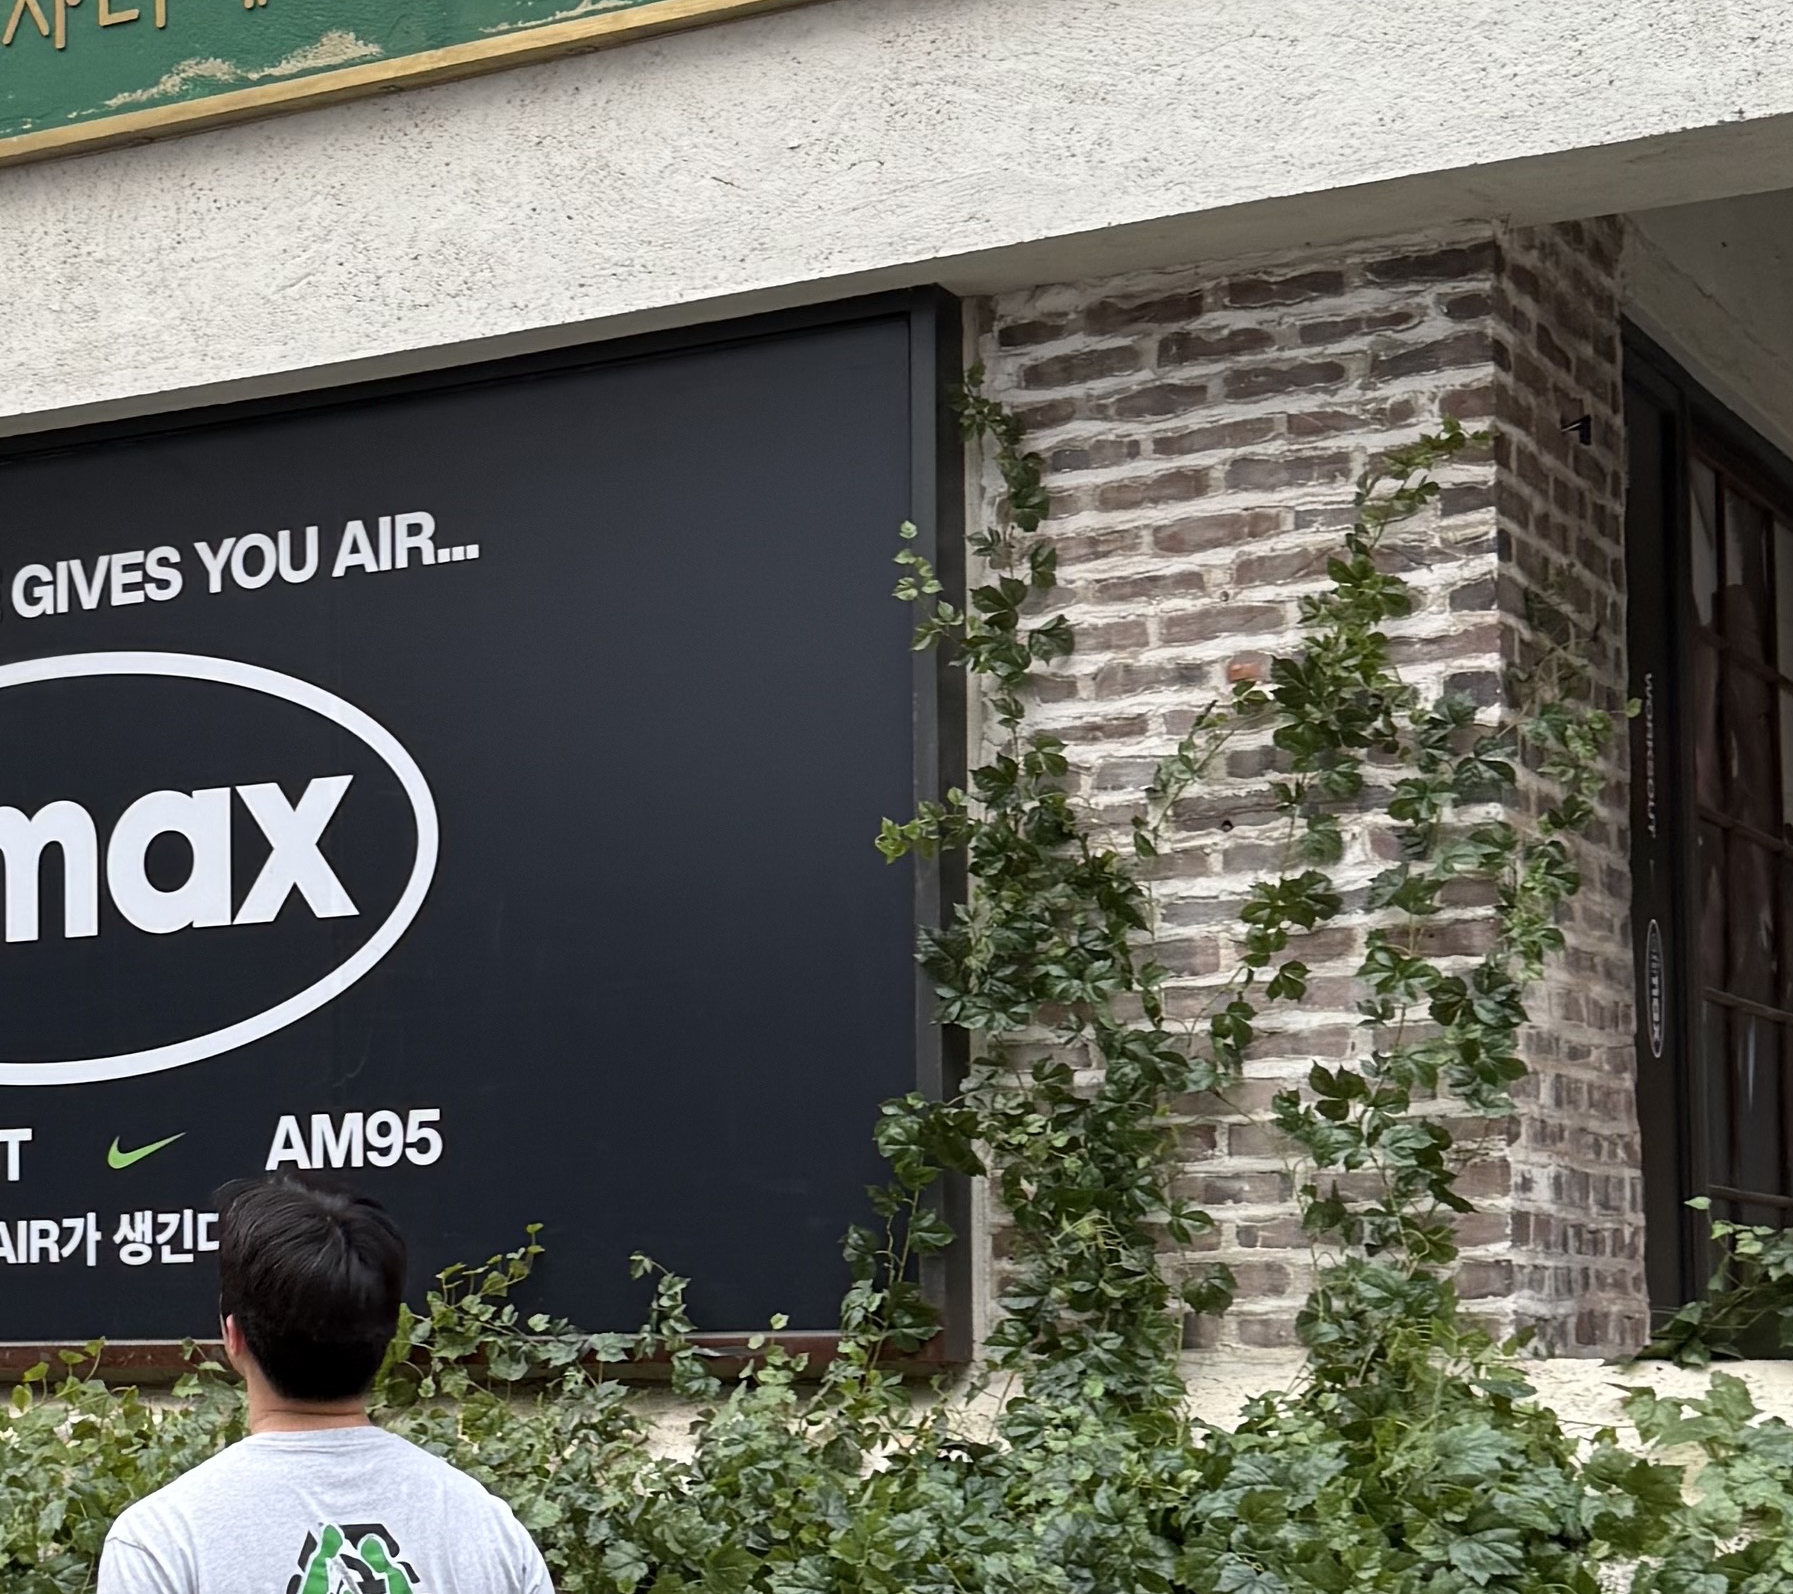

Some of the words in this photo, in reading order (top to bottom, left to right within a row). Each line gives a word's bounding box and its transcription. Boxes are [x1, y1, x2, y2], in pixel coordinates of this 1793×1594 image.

[12, 546, 182, 618] GIVES
[194, 526, 318, 594] YOU
[332, 511, 480, 577] AIR...
[265, 1109, 443, 1171] AM95
